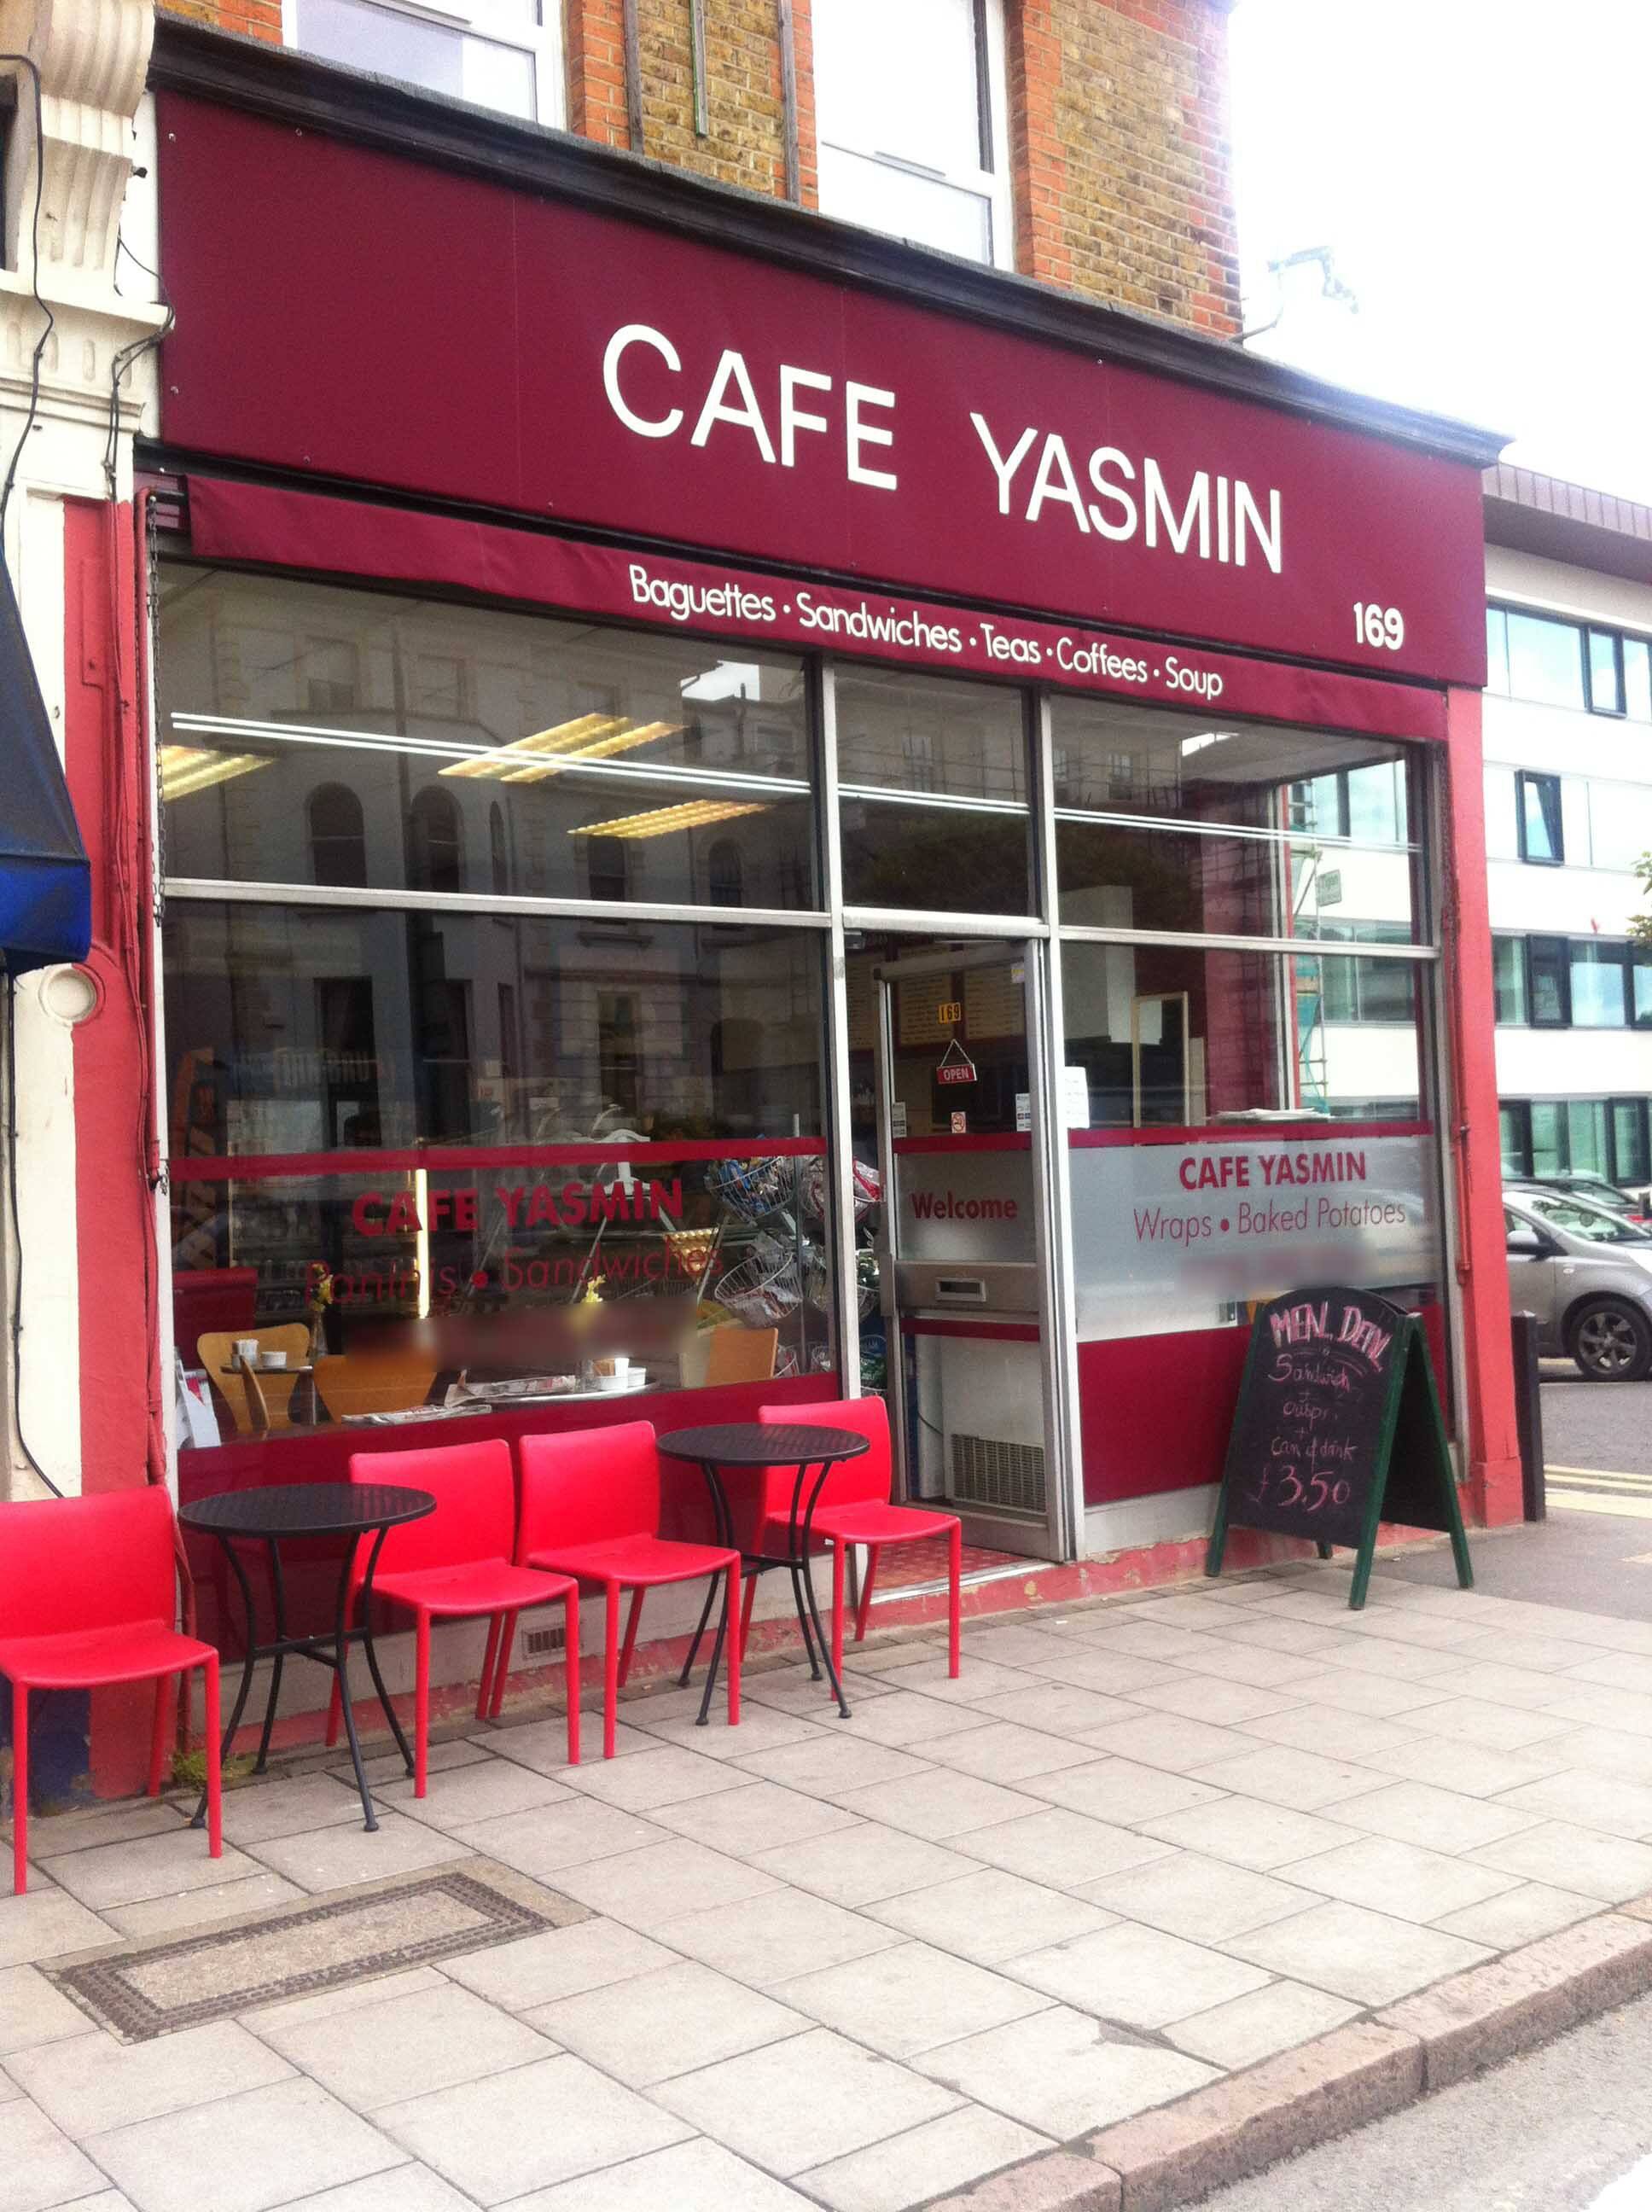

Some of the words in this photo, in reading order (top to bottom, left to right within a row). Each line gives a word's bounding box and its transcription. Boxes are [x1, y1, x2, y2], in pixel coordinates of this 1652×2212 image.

[604, 324, 898, 490] CAFE
[970, 412, 1283, 573] YASMIN
[630, 565, 776, 621] Baguettes
[797, 592, 962, 654] Sandwiches
[980, 624, 1040, 663] Teas
[1056, 637, 1147, 681] Coffees
[1166, 656, 1223, 698] Soup
[1353, 602, 1405, 651] 169
[941, 1003, 961, 1022] 169
[942, 1068, 969, 1080] OPEN
[1179, 1155, 1250, 1190] CAFE
[1258, 1150, 1365, 1185] YASMIN
[352, 1188, 478, 1237] CAFE
[496, 1179, 683, 1227] YASMIN
[912, 1194, 1018, 1220] Welcome
[1133, 1208, 1212, 1247] Wraps
[1238, 1198, 1307, 1235] Baked
[1318, 1196, 1406, 1229] Potatoes
[501, 1234, 725, 1292] Sandwiches
